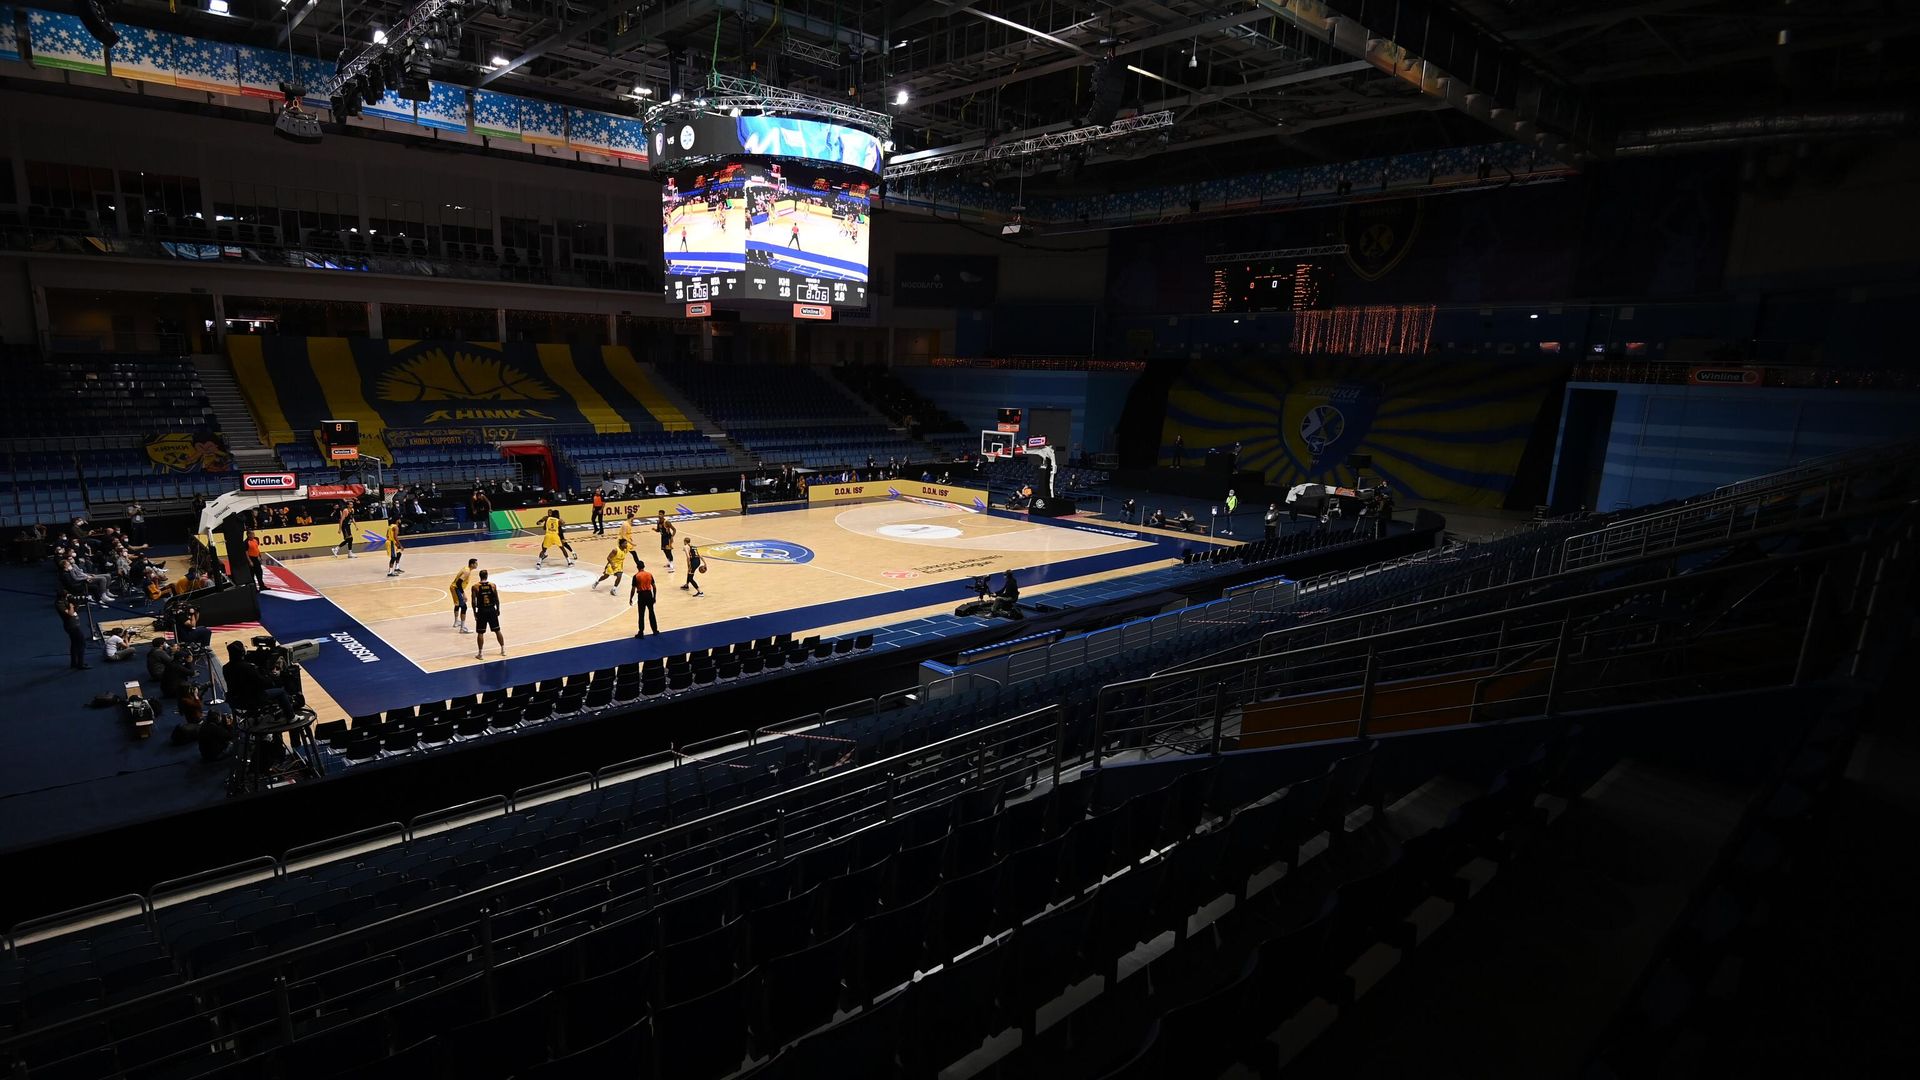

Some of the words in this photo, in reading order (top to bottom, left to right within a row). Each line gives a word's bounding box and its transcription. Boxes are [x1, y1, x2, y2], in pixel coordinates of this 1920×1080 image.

[780, 286, 791, 297] 18
[834, 291, 845, 302] 18
[1701, 372, 1743, 381] Winline
[335, 423, 342, 432] 8
[483, 428, 517, 441] 1997
[249, 477, 281, 485] Winline
